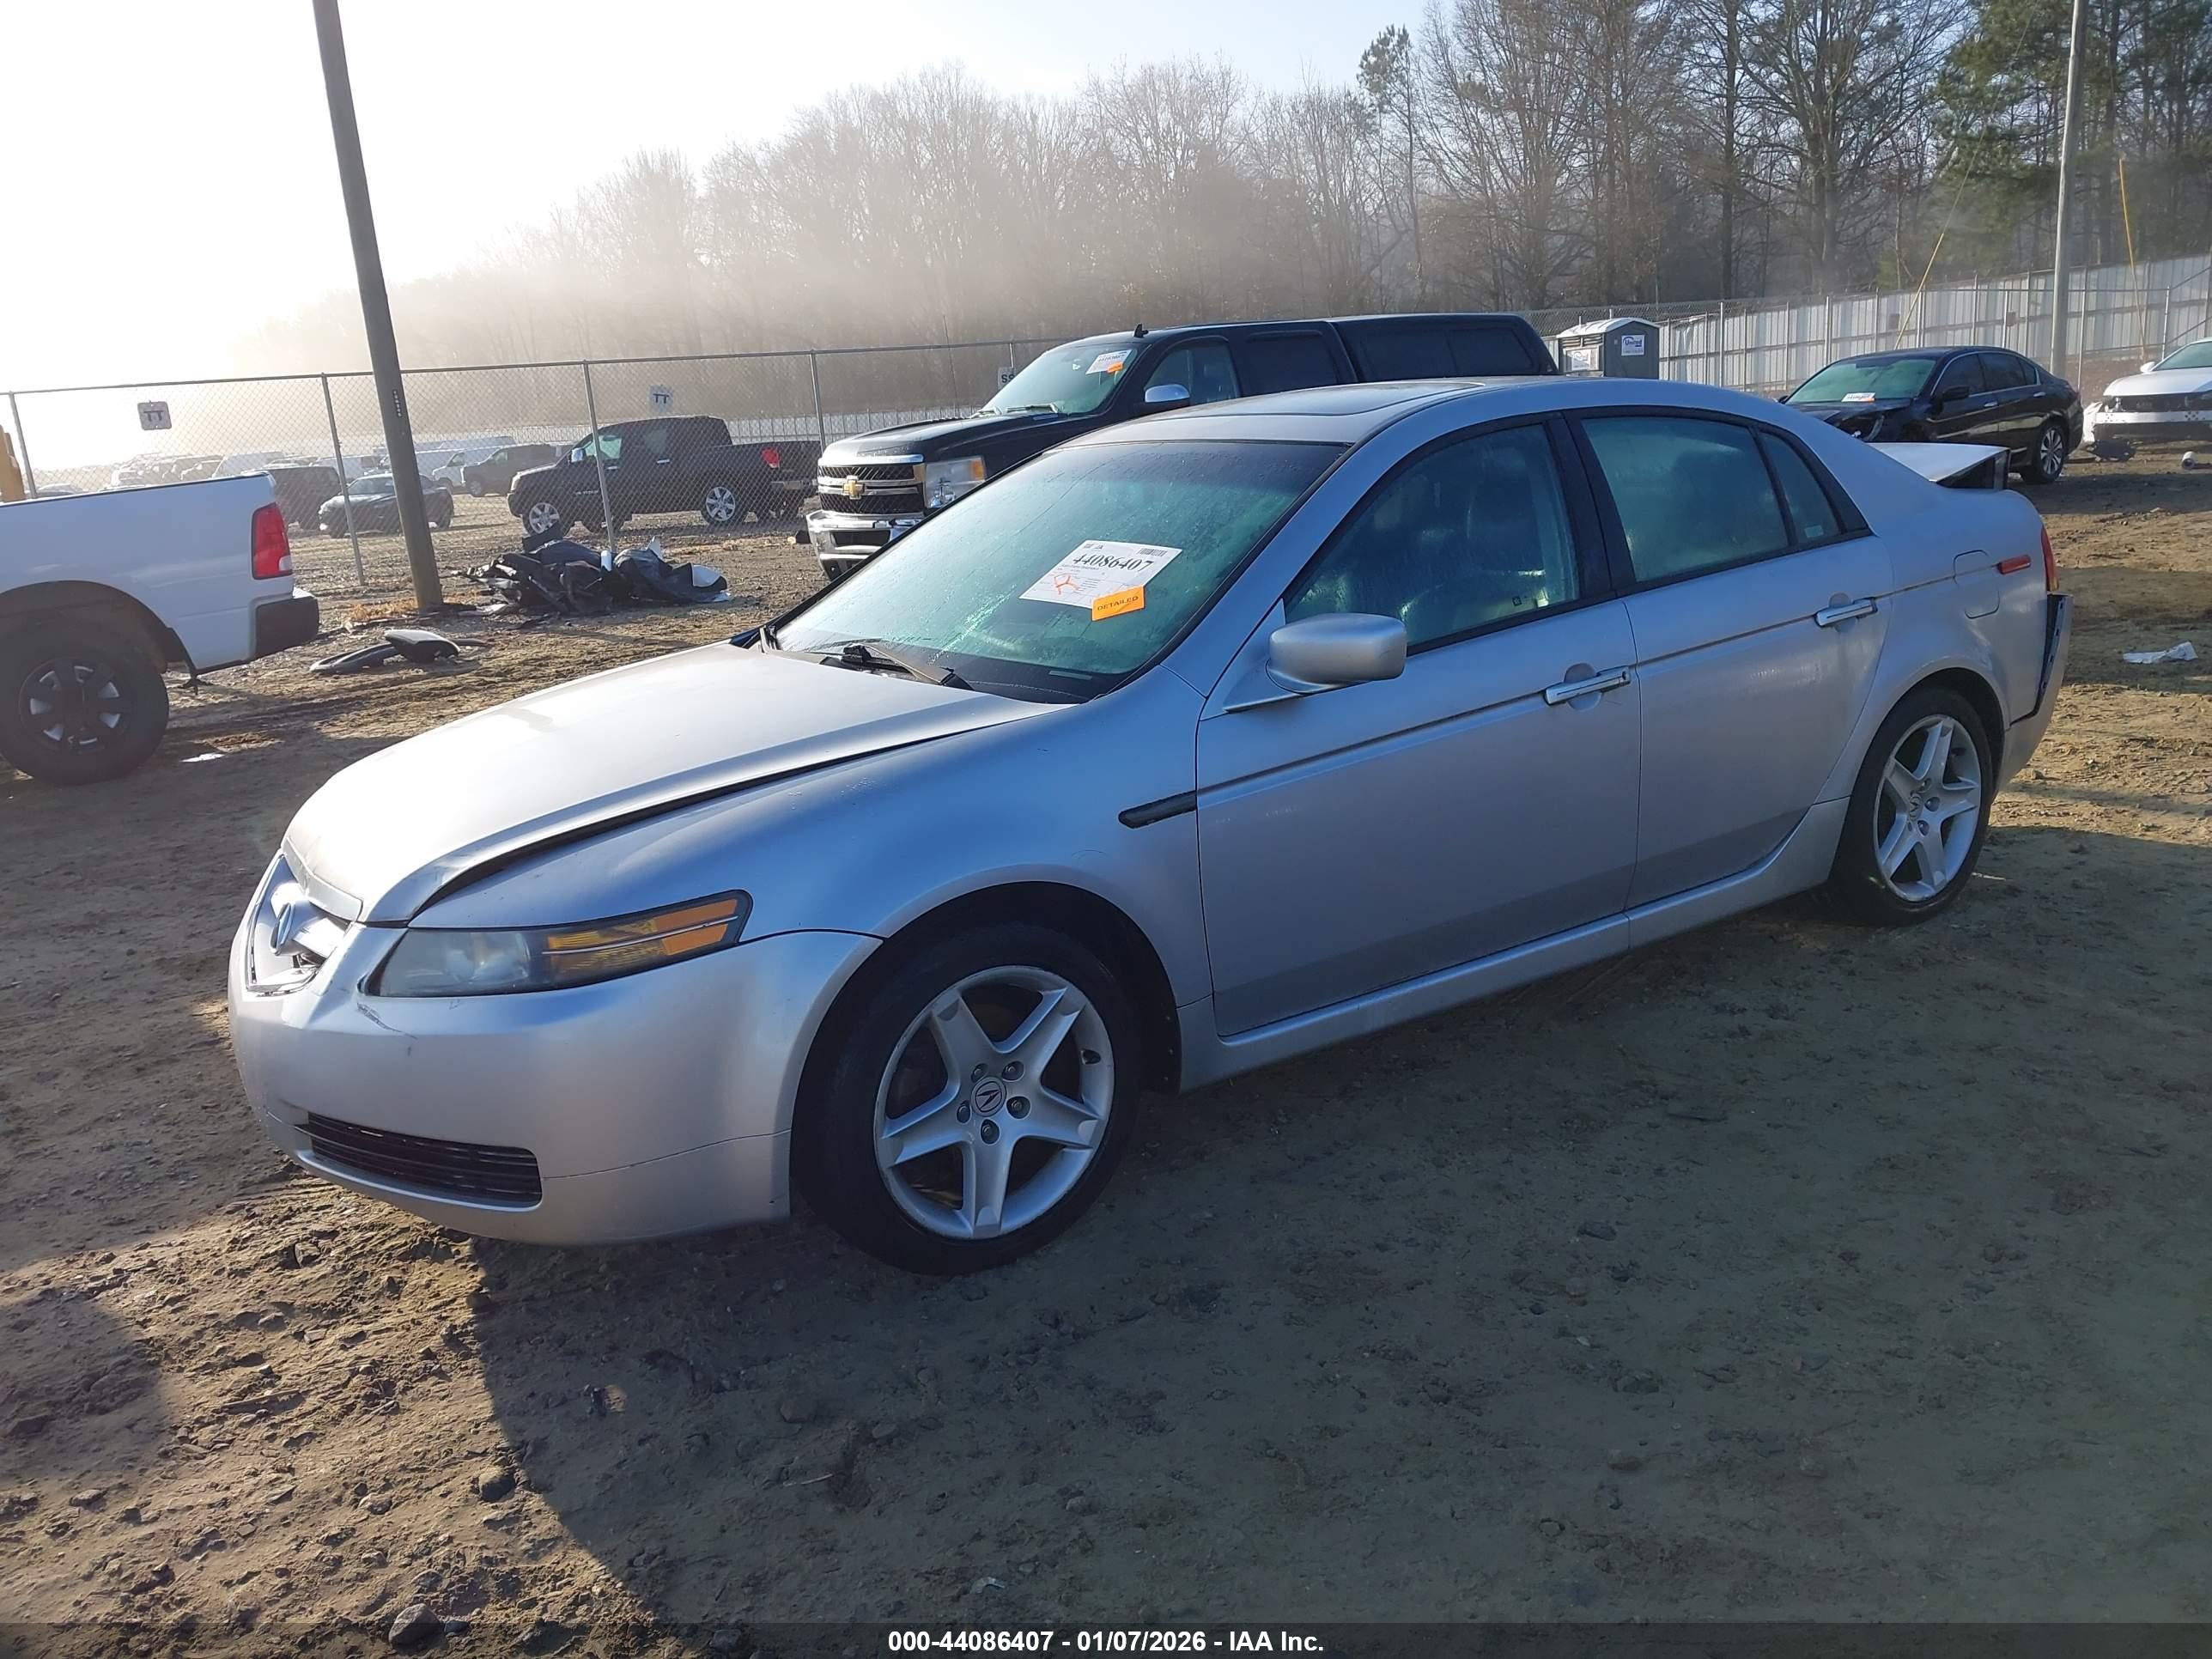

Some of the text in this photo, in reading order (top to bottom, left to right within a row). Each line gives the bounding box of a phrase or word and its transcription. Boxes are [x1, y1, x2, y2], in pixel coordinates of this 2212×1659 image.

[653, 393, 670, 404] TT
[143, 410, 165, 422] TT
[1073, 554, 1154, 572] 44086407
[1097, 595, 1139, 611] DETAILED
